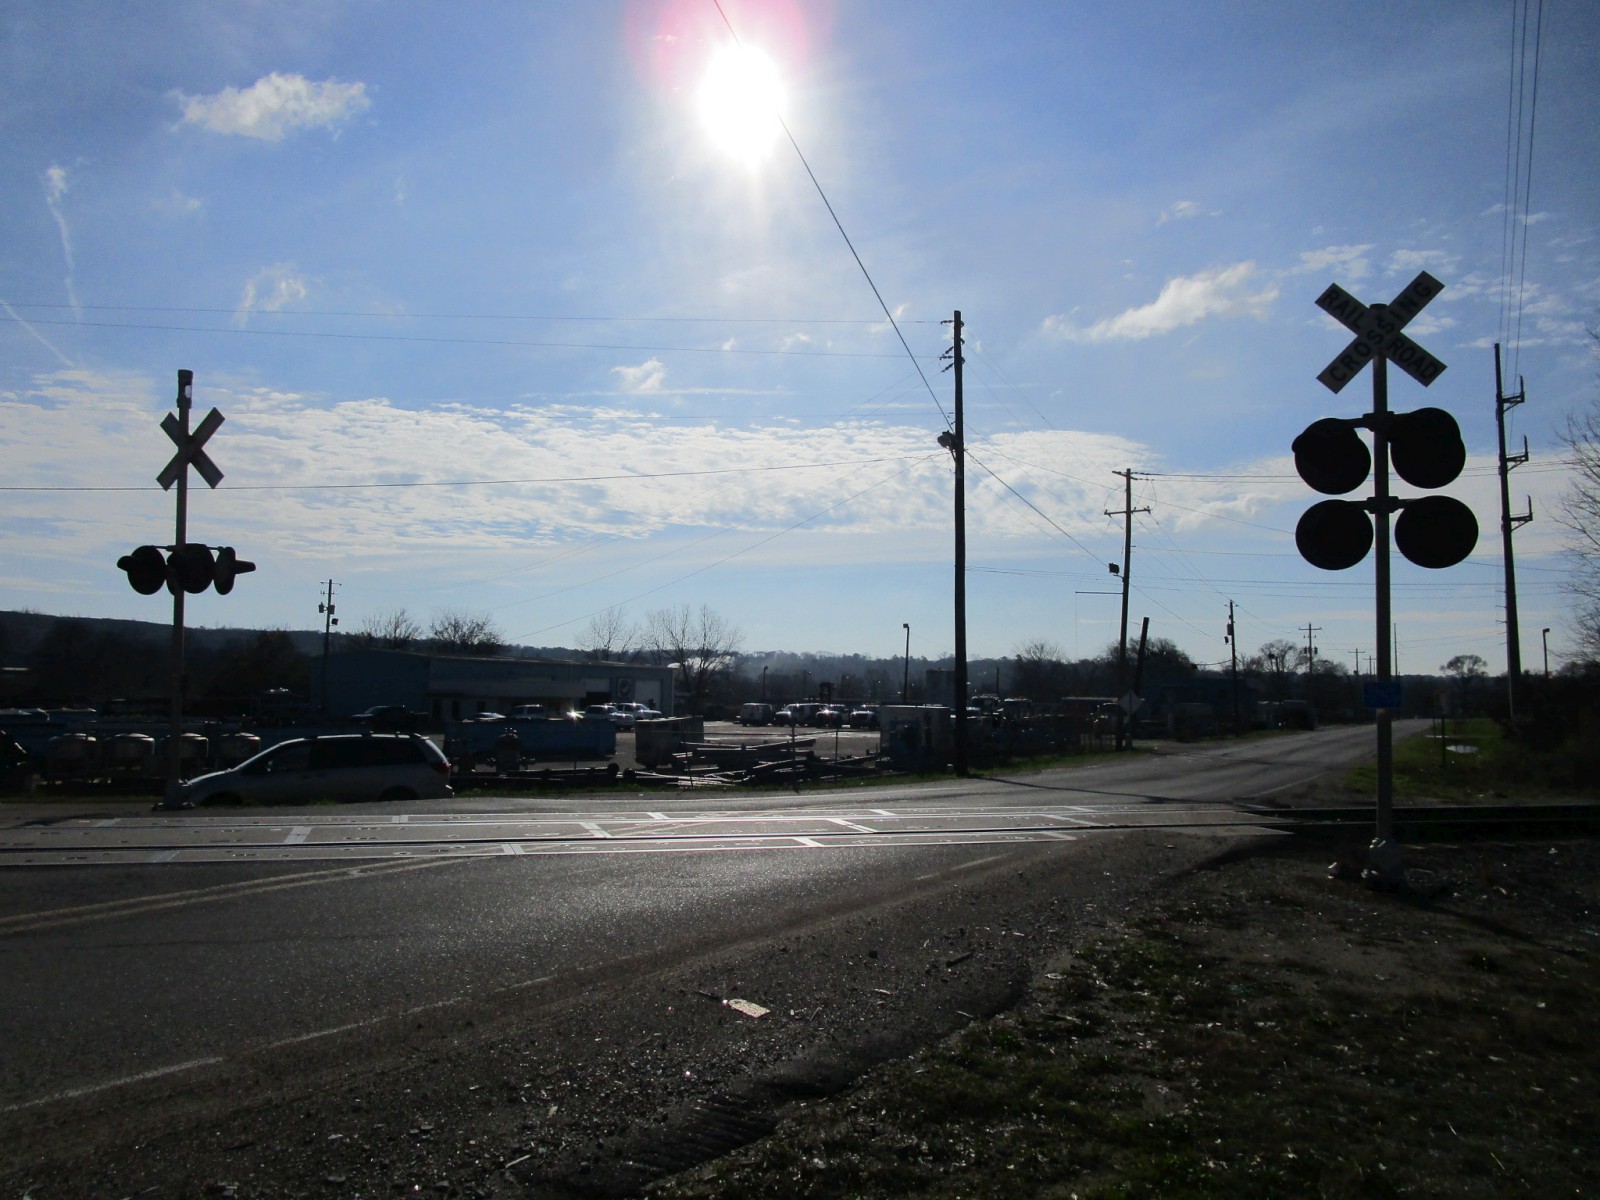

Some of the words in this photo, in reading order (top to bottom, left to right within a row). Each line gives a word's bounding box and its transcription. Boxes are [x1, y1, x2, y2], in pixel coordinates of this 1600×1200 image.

[1322, 290, 1364, 329] RAIL
[1387, 338, 1438, 379] ROAD
[1330, 282, 1431, 382] CROSSING
